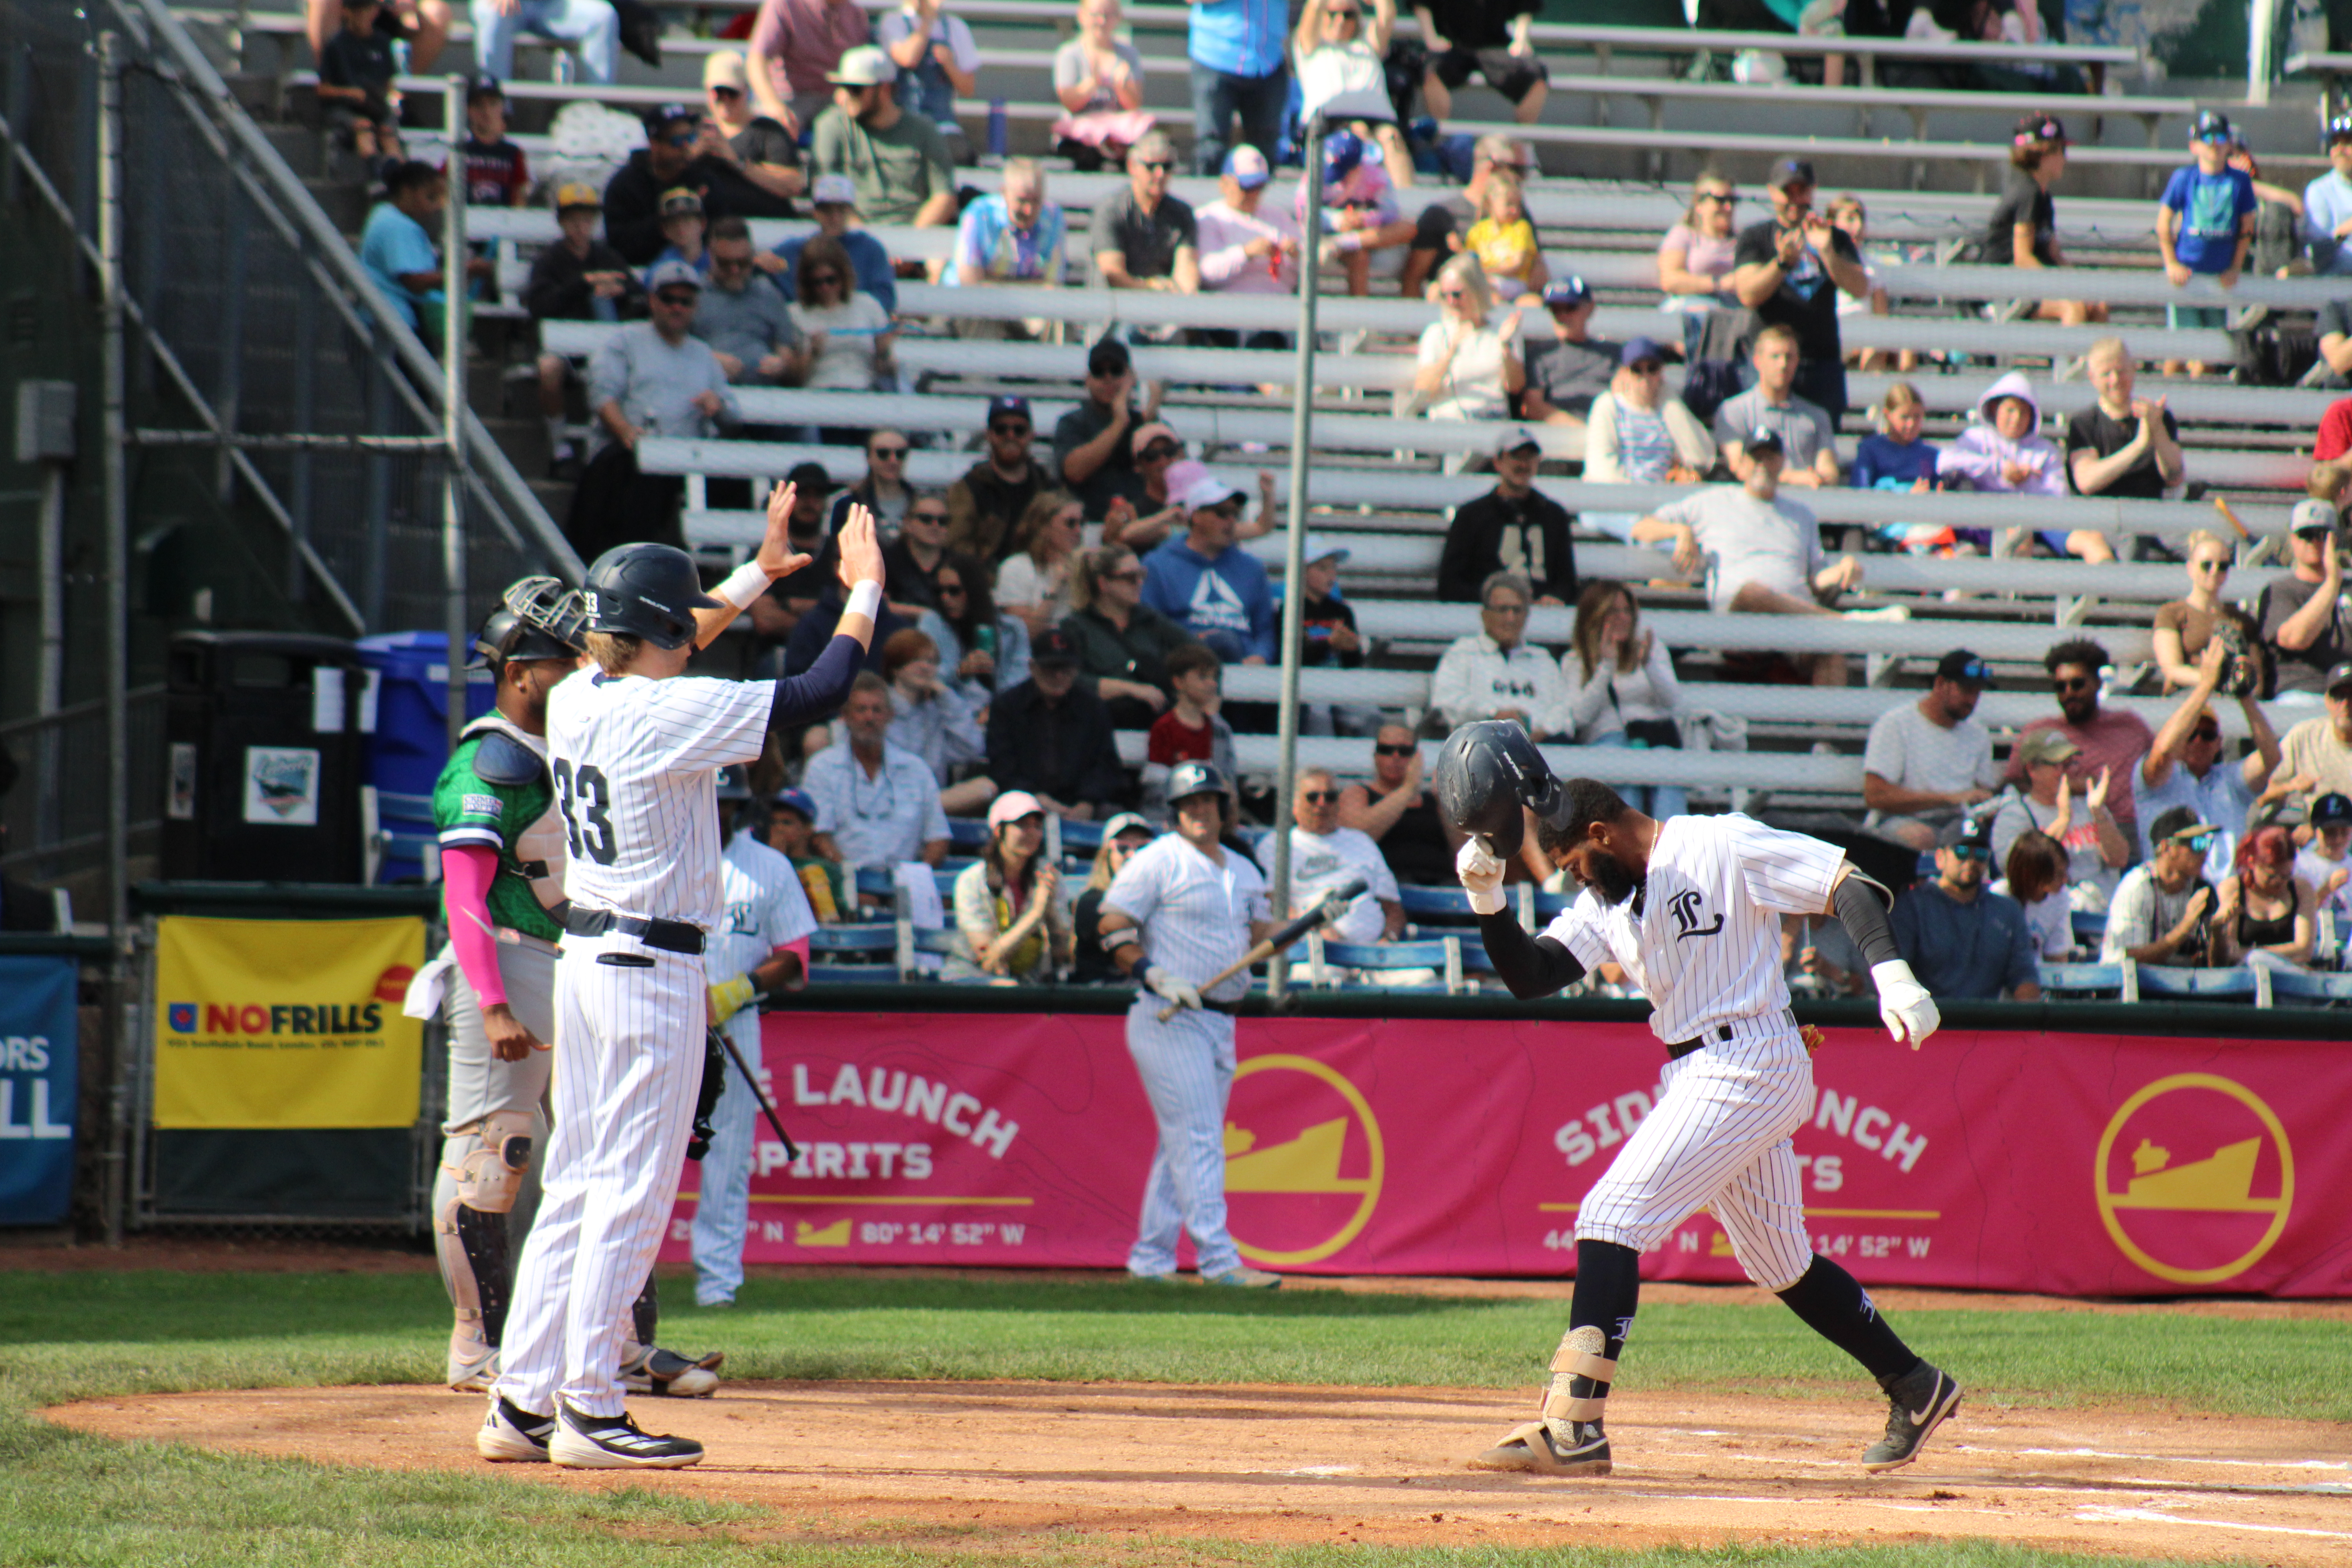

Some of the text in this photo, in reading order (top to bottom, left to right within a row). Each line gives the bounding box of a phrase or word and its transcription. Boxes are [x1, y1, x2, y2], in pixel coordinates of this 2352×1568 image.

[1499, 524, 1546, 582] 41
[584, 591, 598, 613] 33
[553, 757, 618, 867] 33
[1667, 888, 1724, 943] L
[0, 1035, 49, 1071] RS
[793, 1063, 1019, 1160] LAUNCH
[1812, 1084, 1929, 1174] NCH
[764, 1220, 784, 1243] N
[999, 1223, 1025, 1246] W
[1543, 1229, 1574, 1252] 44
[1679, 1231, 1699, 1253] N
[1906, 1236, 1931, 1259] W
